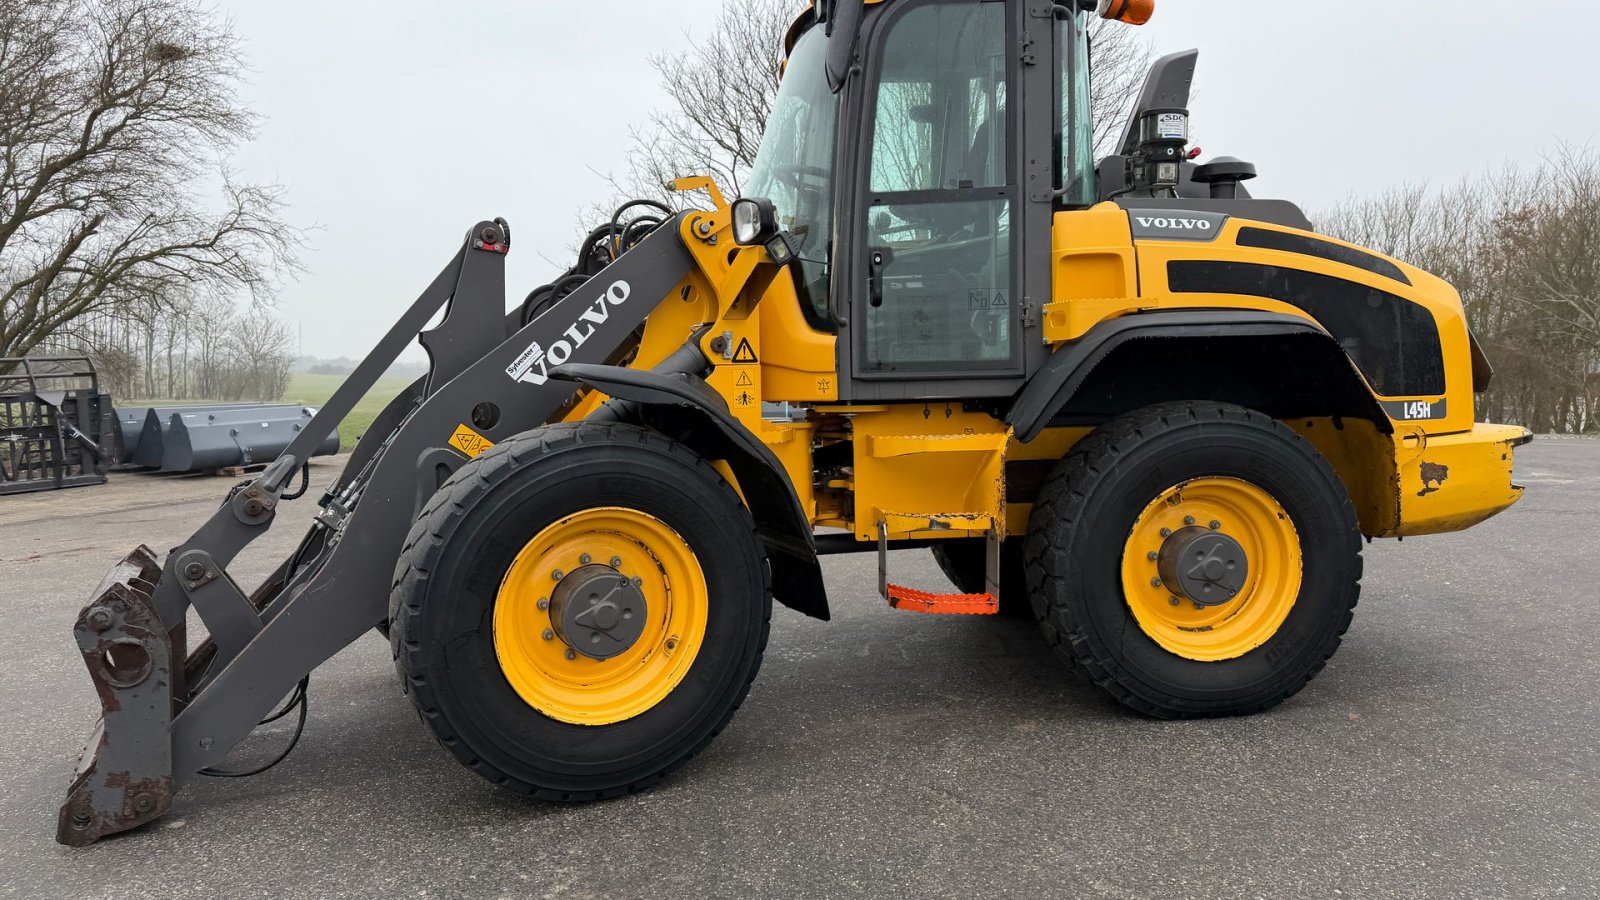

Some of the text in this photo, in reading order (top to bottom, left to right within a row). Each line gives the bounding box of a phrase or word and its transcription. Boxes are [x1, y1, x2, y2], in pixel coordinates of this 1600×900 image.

[1135, 216, 1211, 230] VOLVO
[517, 279, 631, 386] VOLVO
[507, 347, 534, 374] Sylvester
[1403, 401, 1431, 419] L45H
